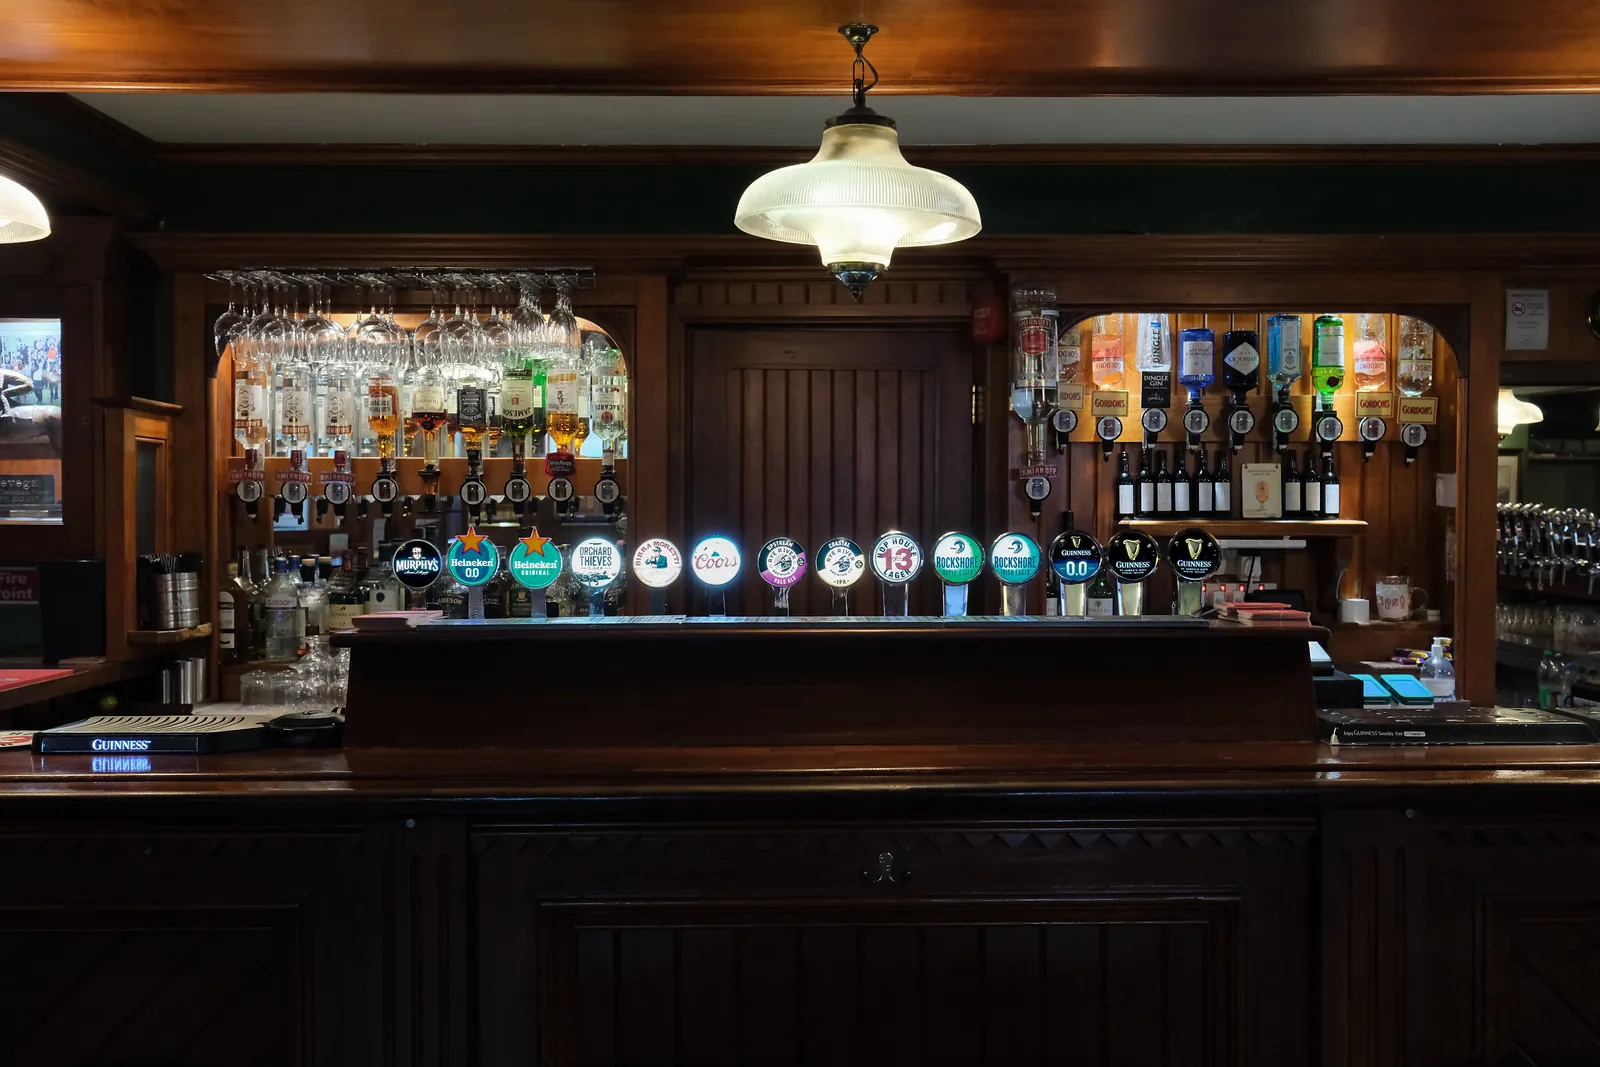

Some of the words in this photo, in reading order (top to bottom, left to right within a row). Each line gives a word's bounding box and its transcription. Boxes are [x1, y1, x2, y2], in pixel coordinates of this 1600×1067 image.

[1152, 329, 1161, 364] DINGLE
[1022, 467, 1057, 476] SMIRNOFF
[766, 540, 794, 551] UPSTREAM
[828, 540, 851, 549] COASTAL
[877, 541, 889, 558] HOP
[892, 537, 917, 557] HOUSE
[580, 547, 612, 556] ORCHARD
[636, 543, 652, 566] BIRRA
[653, 541, 680, 565] MORETTI
[768, 551, 778, 563] RYE
[777, 547, 797, 560] RIVER
[826, 550, 837, 563] RYE
[837, 547, 856, 562] RIVER
[451, 558, 493, 567] Heineken
[514, 560, 557, 569] Heineken
[580, 556, 612, 566] THIEVES
[694, 553, 738, 570] Coors
[883, 548, 913, 570] 13
[937, 556, 979, 569] ROCKSHORE
[994, 556, 1037, 569] ROCKSHORE
[1115, 560, 1150, 569] GUINNESS
[1177, 559, 1212, 568] GUINNESS
[465, 568, 480, 578] 0.0
[883, 568, 912, 579] LAGER
[1066, 561, 1088, 576] 0.0
[774, 577, 787, 585] PALE
[787, 575, 797, 584] ALE
[0, 586, 33, 600] oint
[92, 739, 149, 751] GUINNESS
